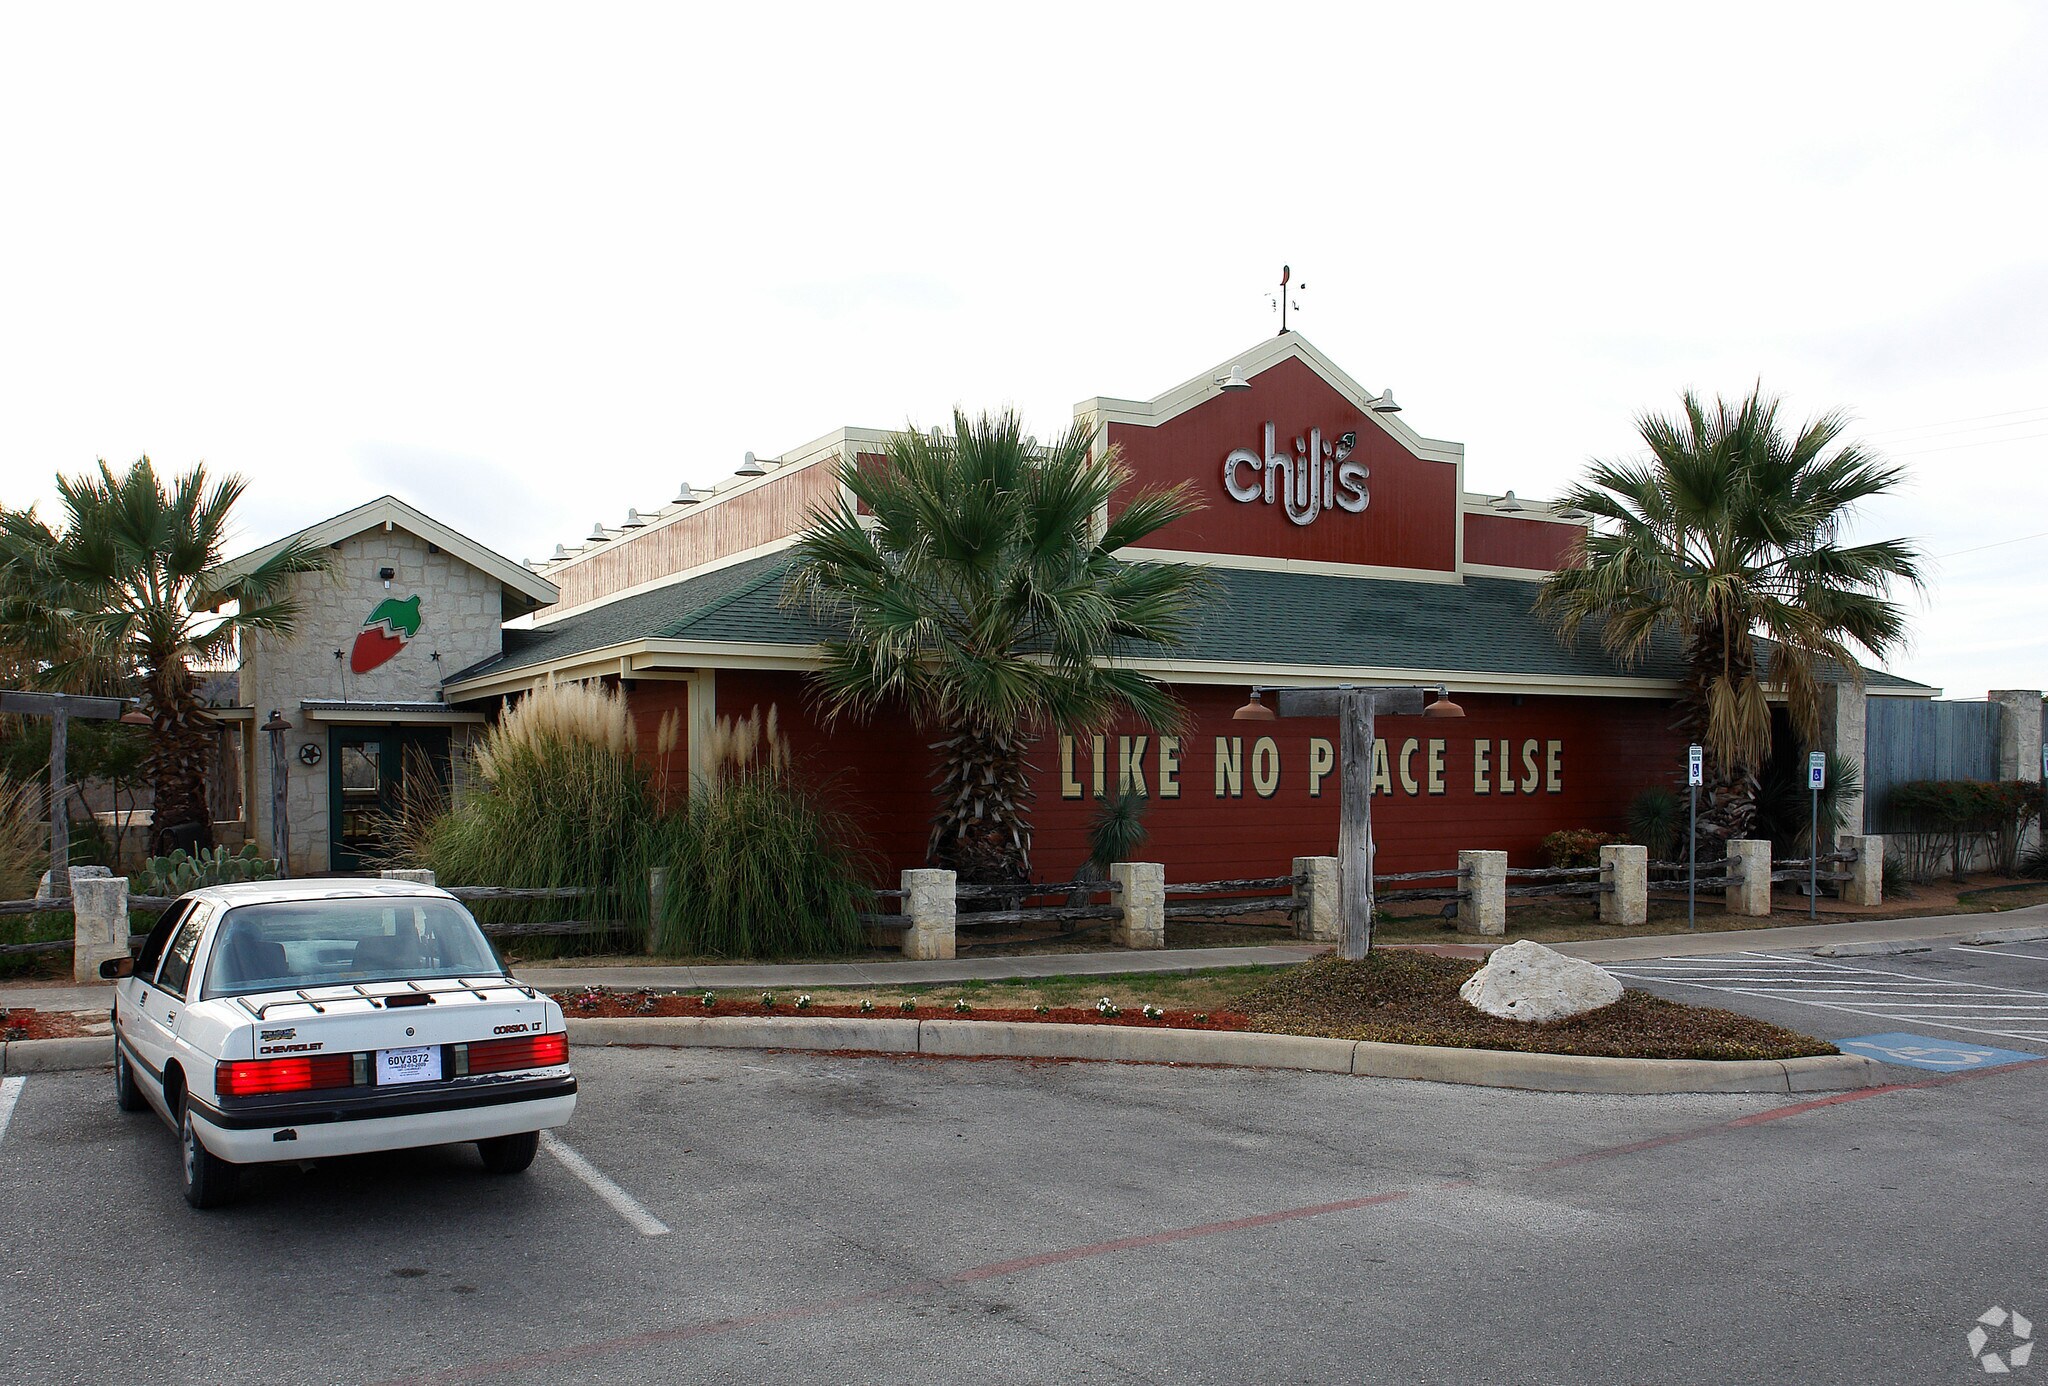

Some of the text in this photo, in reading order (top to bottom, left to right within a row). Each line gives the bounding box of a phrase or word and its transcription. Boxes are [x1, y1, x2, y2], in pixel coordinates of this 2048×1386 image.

[1222, 419, 1371, 526] chili's
[1061, 735, 1563, 798] LIKE NO PACE ELSE
[493, 1021, 543, 1035] CORSICA LT
[260, 1042, 324, 1054] CHEVROLET
[388, 1053, 430, 1066] 60V3872
